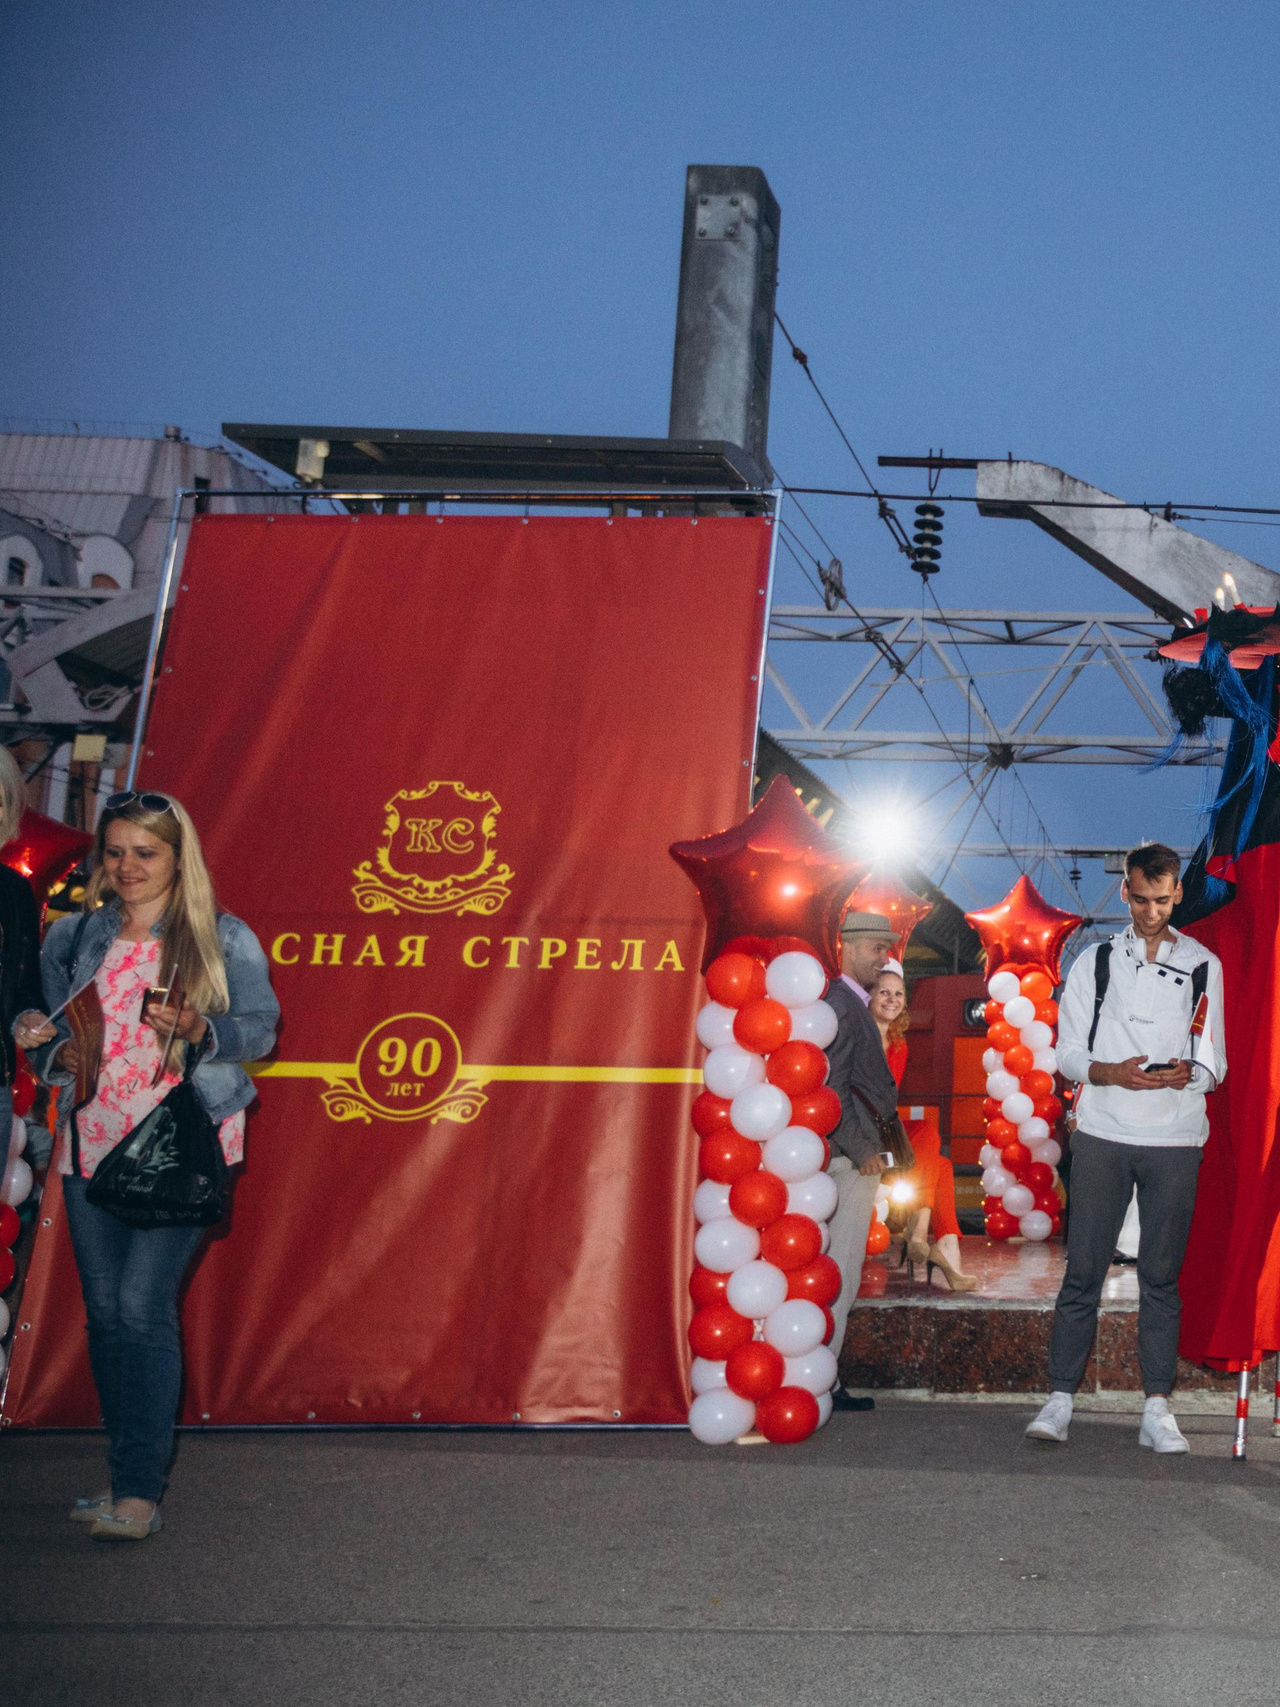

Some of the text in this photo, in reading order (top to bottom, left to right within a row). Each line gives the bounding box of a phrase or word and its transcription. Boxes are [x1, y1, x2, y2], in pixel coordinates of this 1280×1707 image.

[271, 932, 686, 972] СНАЯ СТРЕЛА
[377, 1037, 442, 1077] 90
[385, 1082, 425, 1098] лет
